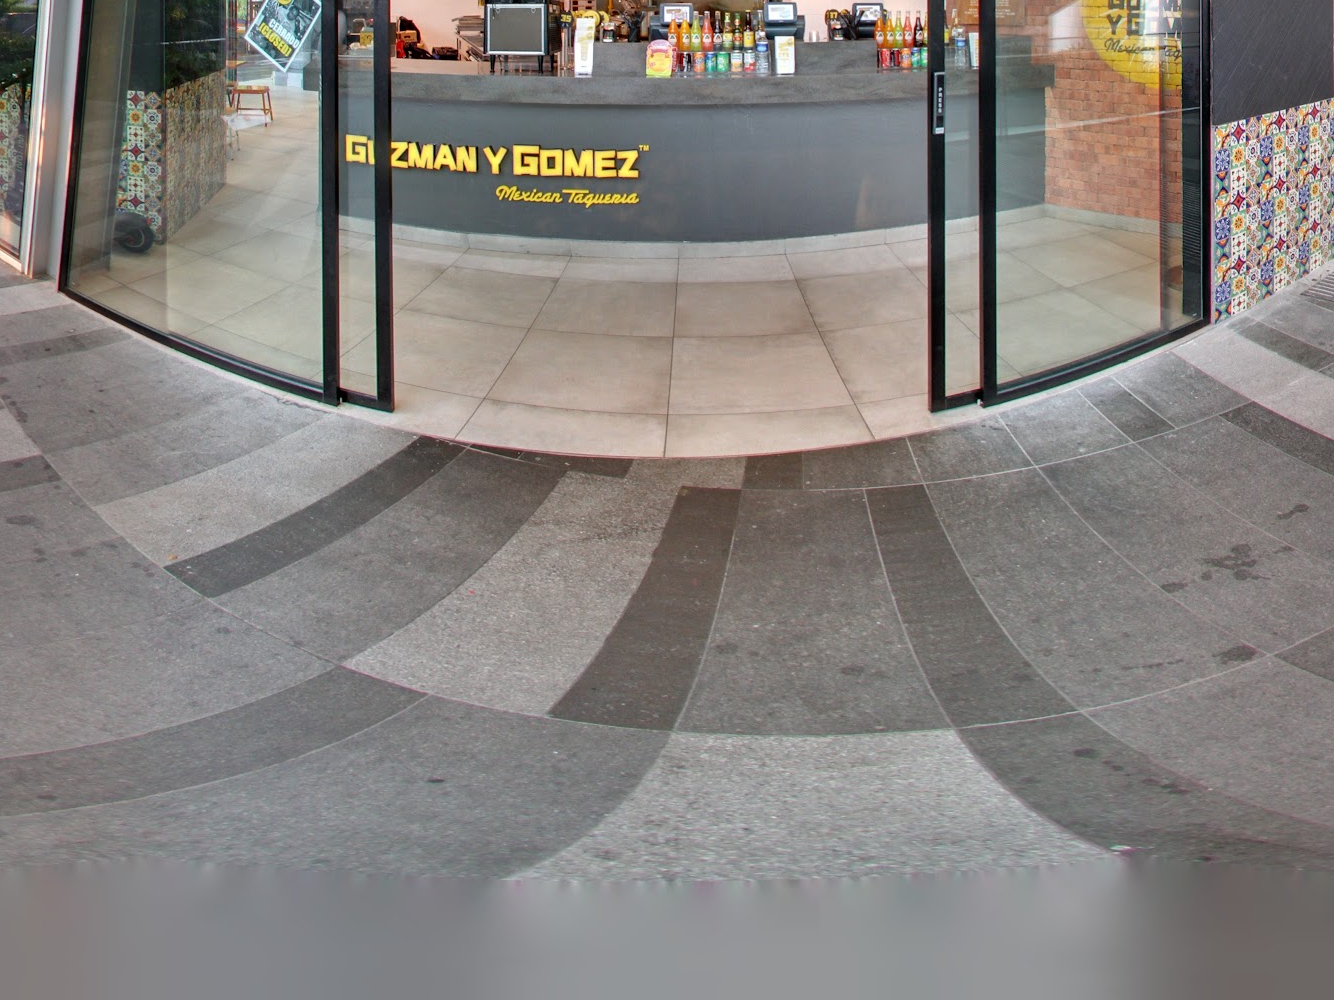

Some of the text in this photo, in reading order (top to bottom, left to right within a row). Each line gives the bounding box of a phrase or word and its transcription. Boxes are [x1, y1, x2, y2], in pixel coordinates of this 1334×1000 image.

[560, 14, 572, 22] 35
[1107, 14, 1122, 35] Y
[268, 18, 300, 49] CERRADO
[484, 146, 507, 174] Y
[513, 144, 639, 178] GOMEZ
[496, 185, 639, 208] Mexican Taqueria
